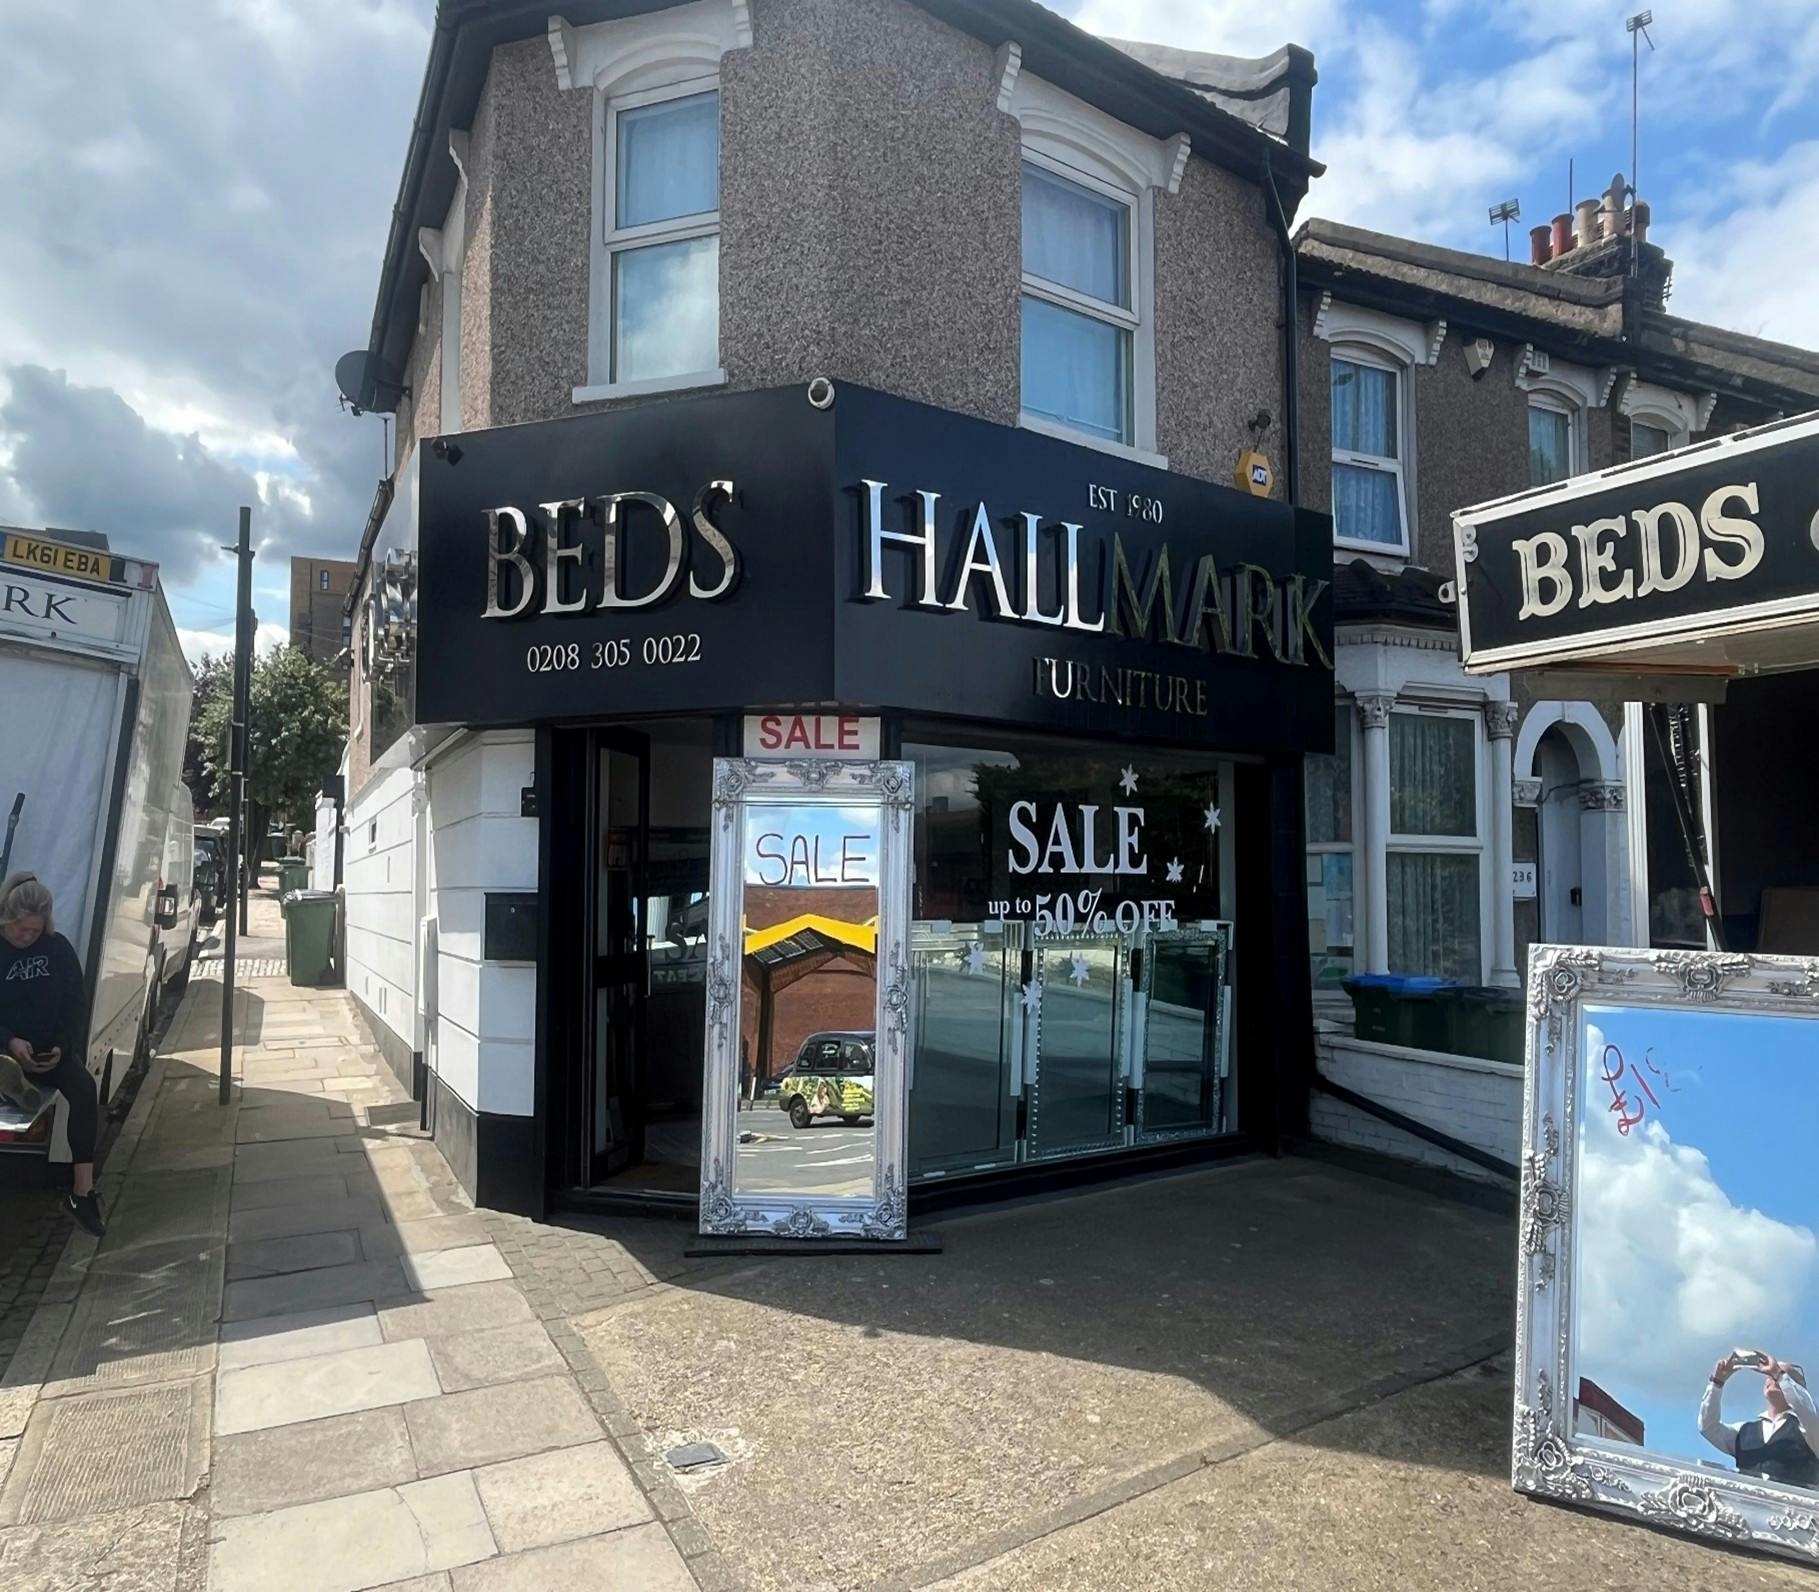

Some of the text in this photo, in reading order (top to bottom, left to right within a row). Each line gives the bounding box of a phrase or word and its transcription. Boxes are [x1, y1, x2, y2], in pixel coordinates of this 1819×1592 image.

[1089, 483, 1164, 525] EST 1980
[63, 552, 101, 577] EBA
[481, 479, 737, 620] BEDS
[1512, 482, 1766, 622] BEDS
[861, 479, 1334, 670] HALLMARK
[527, 633, 702, 673] 0208 305 0022
[1033, 656, 1209, 716] FURNITURE
[759, 715, 860, 750] SALE
[756, 833, 871, 886] SALE
[1008, 800, 1147, 875] SALE
[1512, 871, 1533, 883] 236
[988, 888, 1176, 936] up to 50% OFF
[5, 955, 50, 981] AIR
